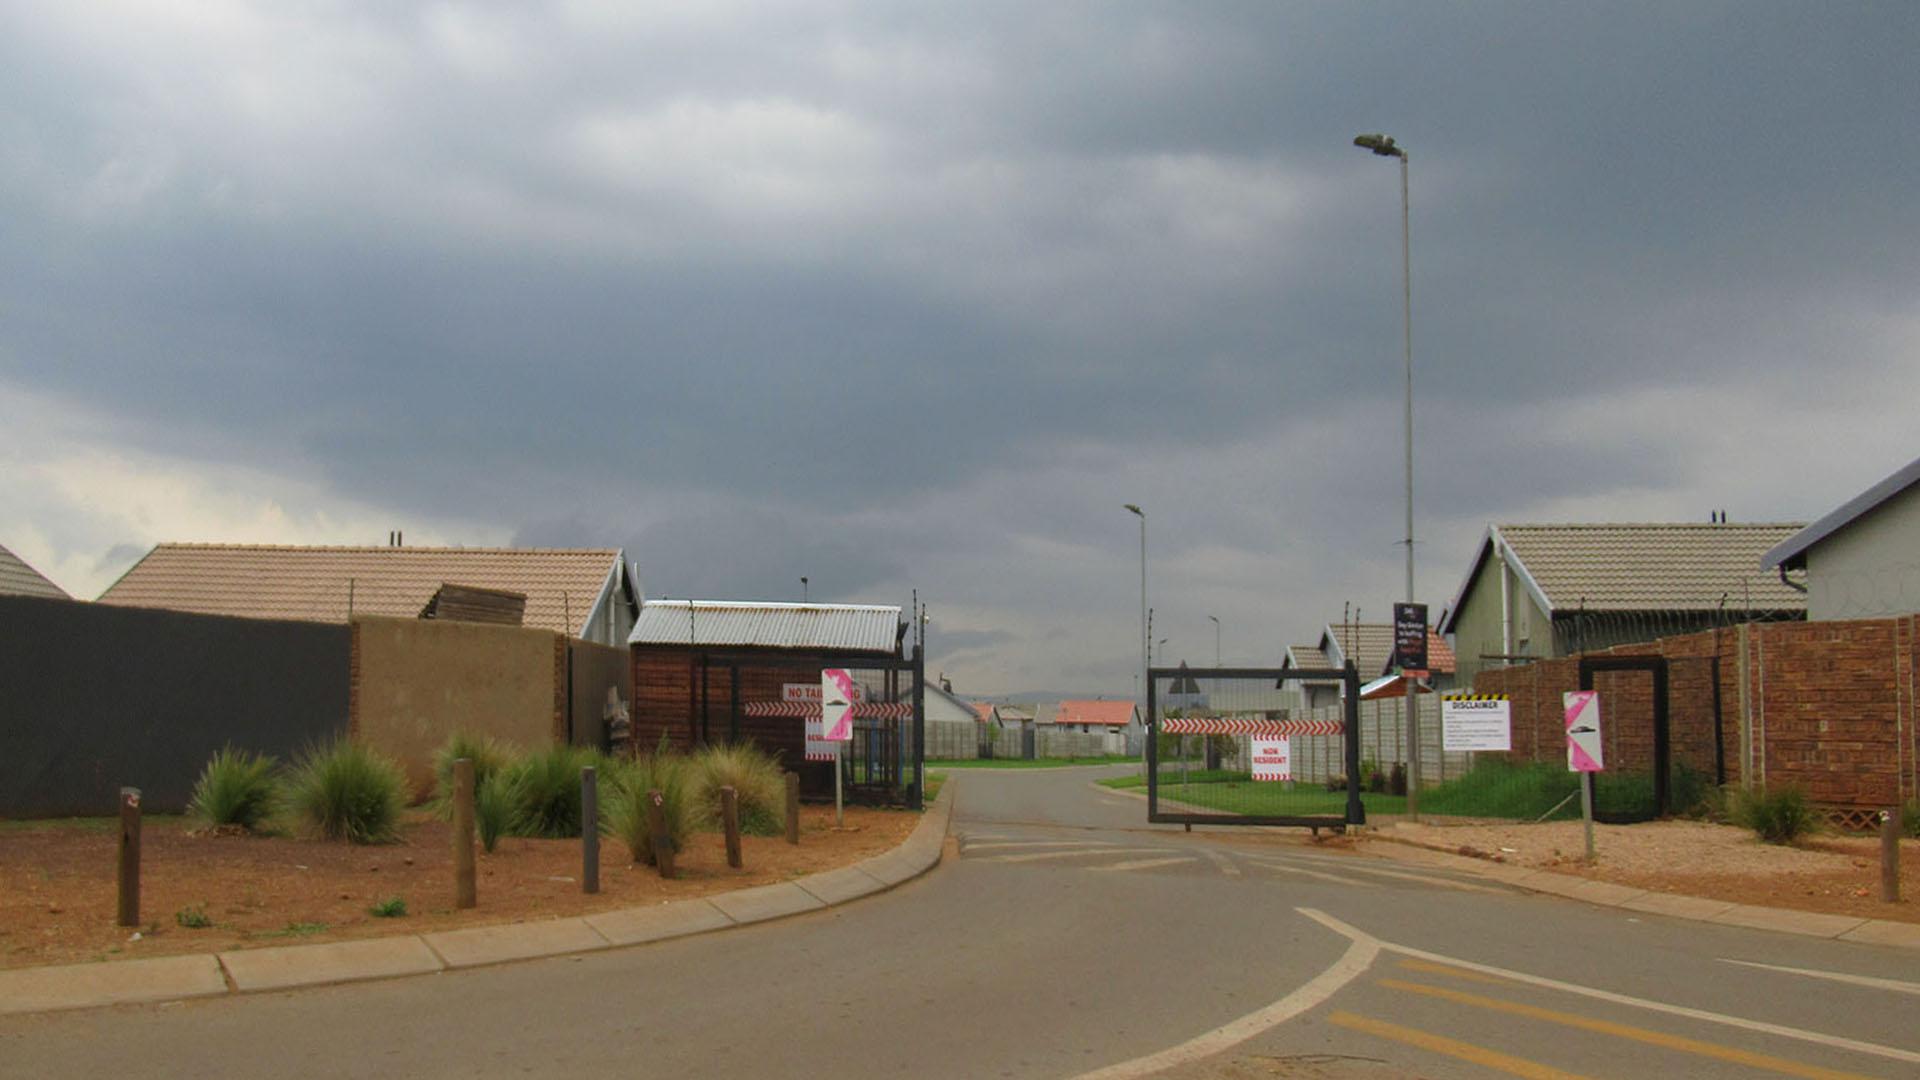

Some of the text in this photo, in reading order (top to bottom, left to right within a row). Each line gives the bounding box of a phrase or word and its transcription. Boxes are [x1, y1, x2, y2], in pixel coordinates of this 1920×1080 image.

[788, 688, 802, 697] NO
[1452, 702, 1498, 710] DISCLAIMER
[1253, 756, 1287, 764] RESIDENT
